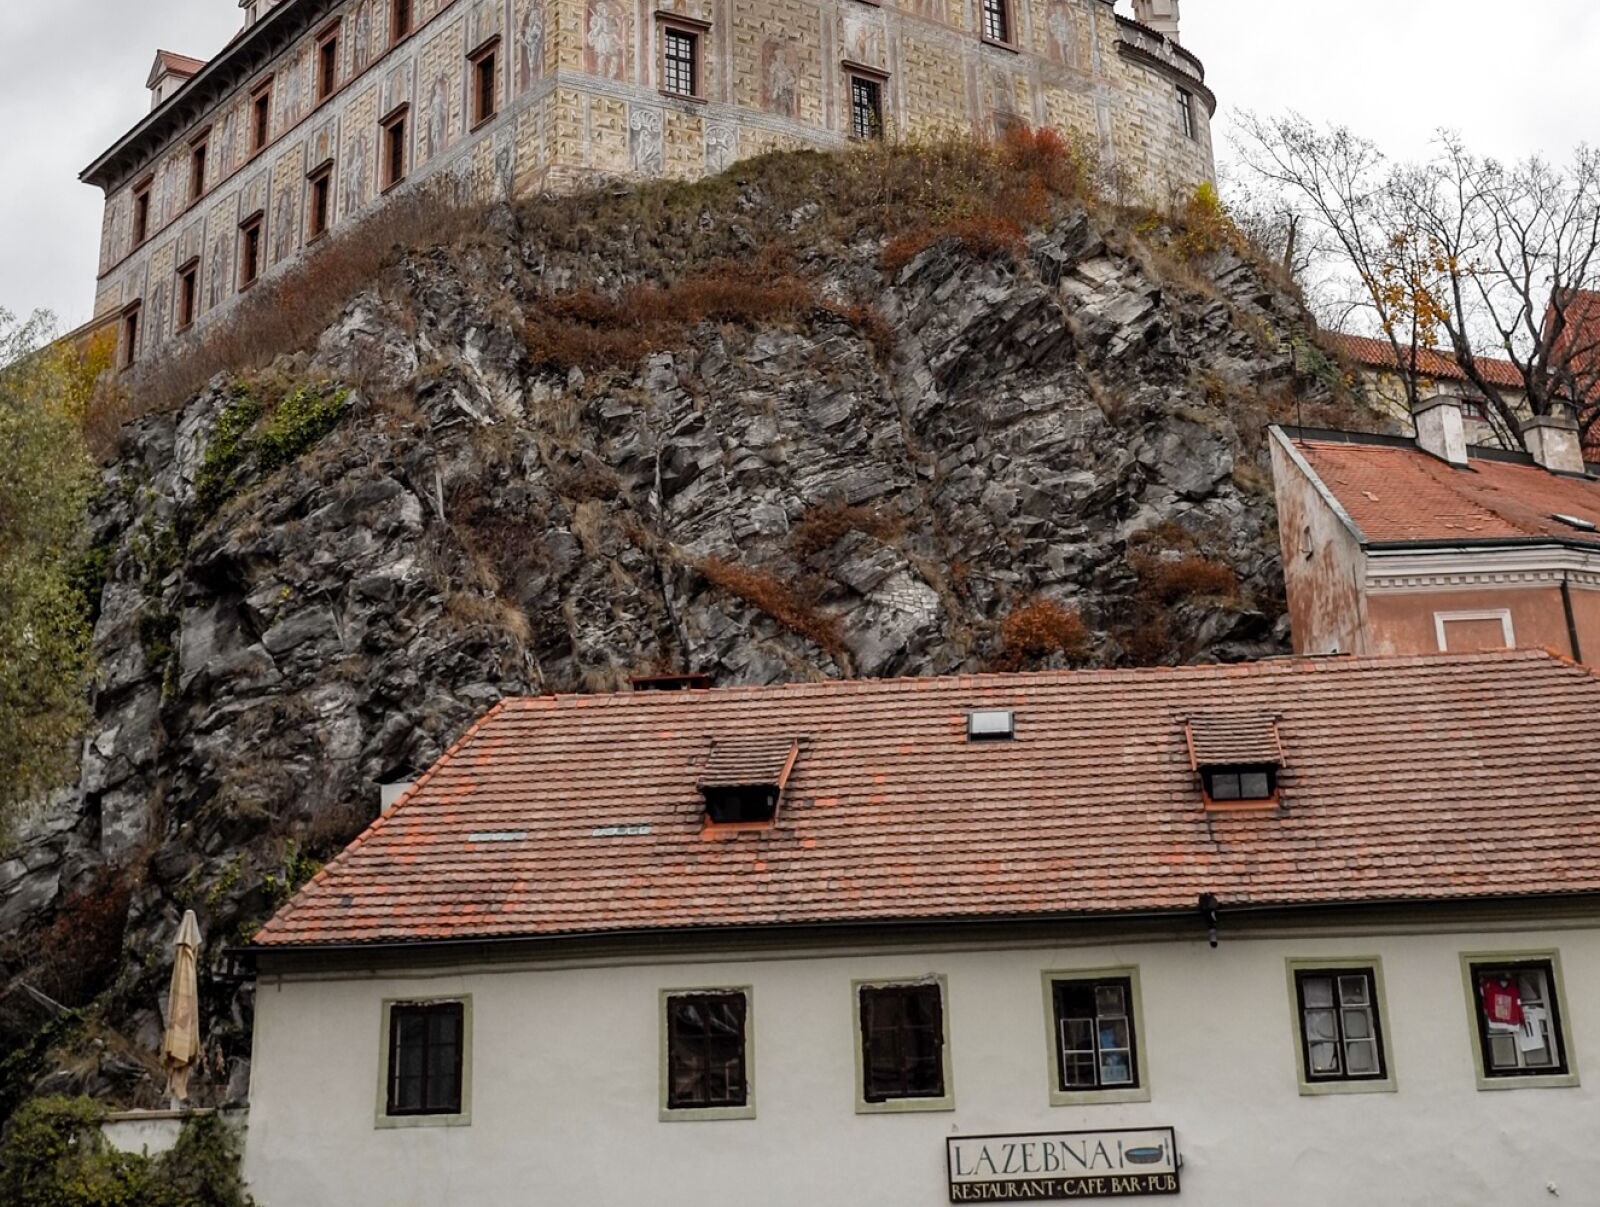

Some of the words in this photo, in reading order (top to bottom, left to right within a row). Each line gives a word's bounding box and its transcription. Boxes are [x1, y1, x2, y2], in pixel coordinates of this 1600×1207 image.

[955, 1140, 1113, 1176] LAZEBNA
[952, 1180, 1055, 1199] RESTAURANT
[1064, 1178, 1106, 1195] CAFE
[1112, 1176, 1141, 1192] BAR
[1148, 1175, 1176, 1191] PUB
